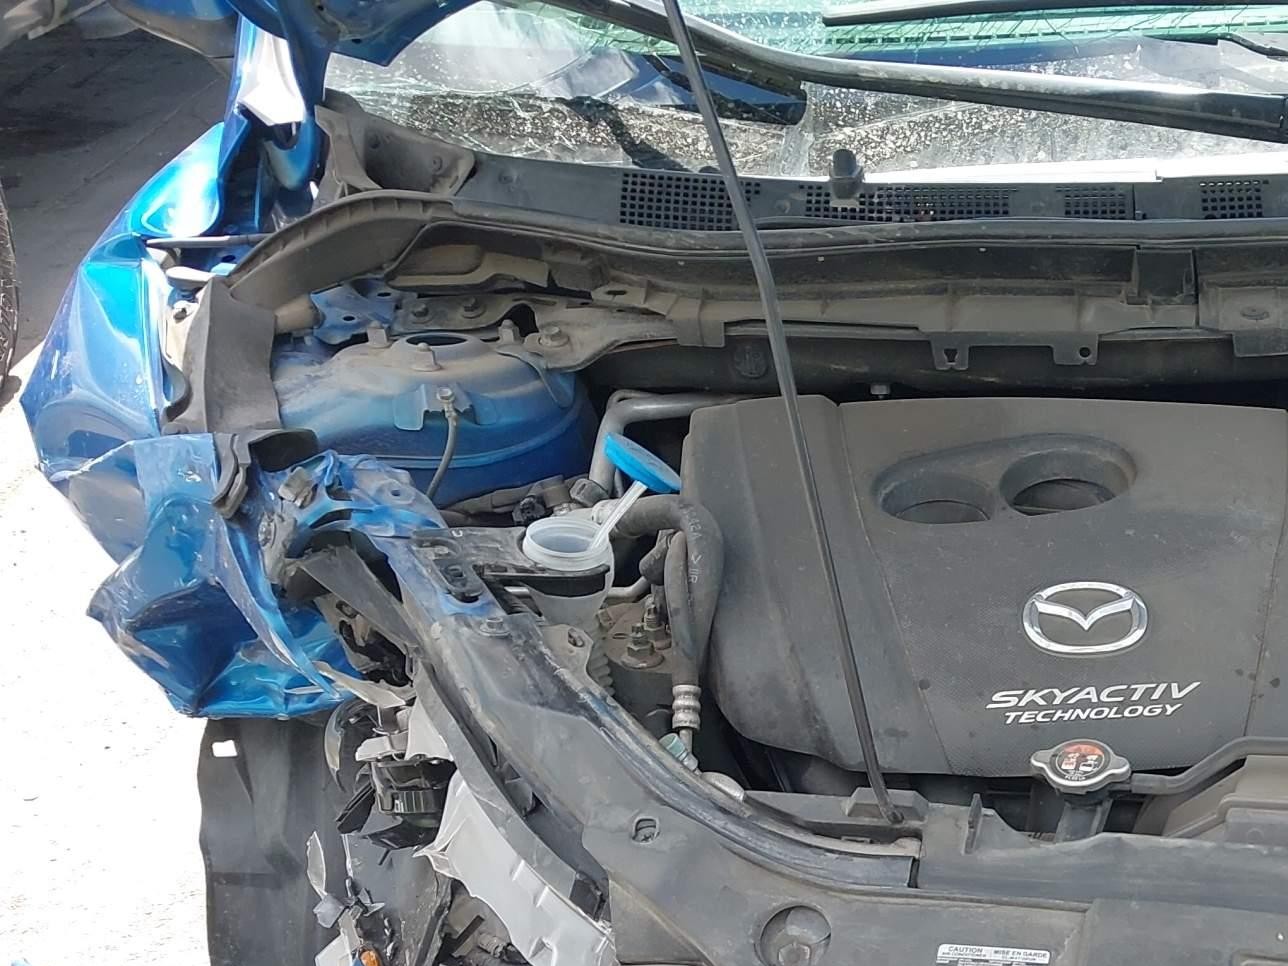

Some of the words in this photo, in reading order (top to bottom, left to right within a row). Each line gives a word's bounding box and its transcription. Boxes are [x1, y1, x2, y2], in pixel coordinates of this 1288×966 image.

[986, 682, 1201, 709] SKYACTIV
[1005, 703, 1184, 724] TECHNOLOGY
[948, 946, 983, 954] CAUTION
